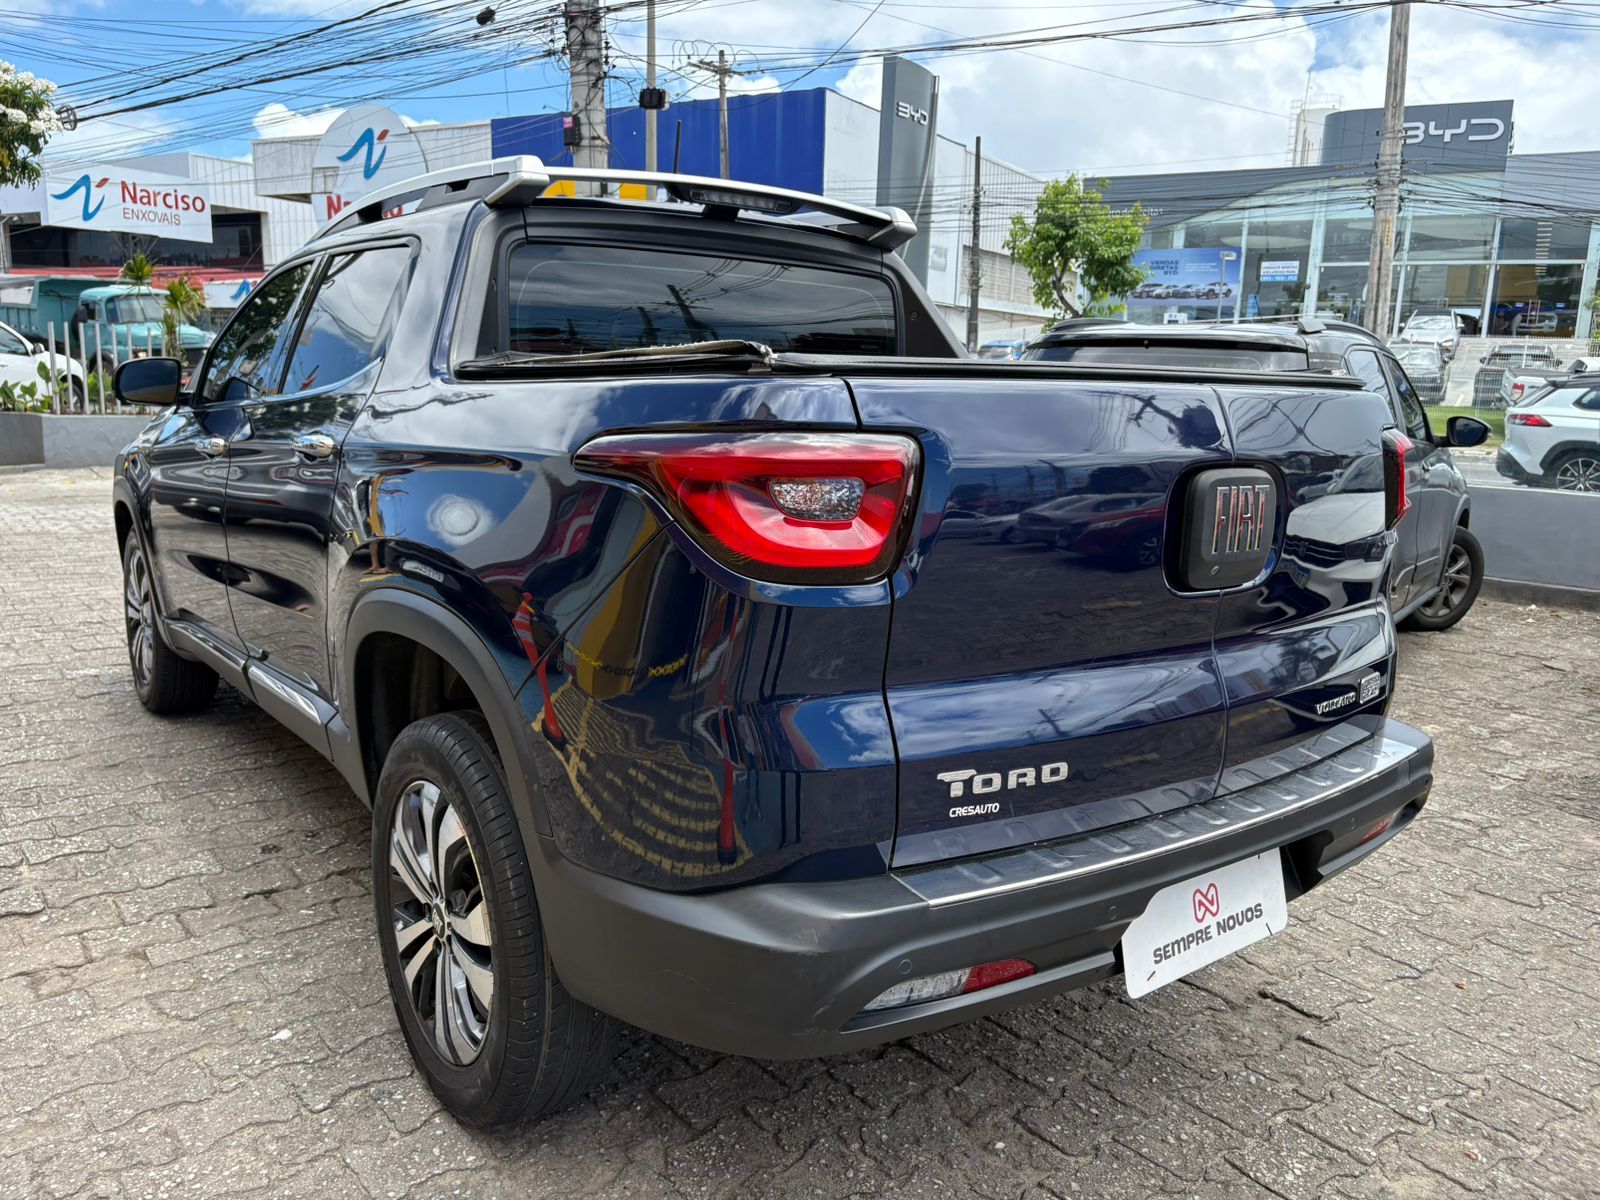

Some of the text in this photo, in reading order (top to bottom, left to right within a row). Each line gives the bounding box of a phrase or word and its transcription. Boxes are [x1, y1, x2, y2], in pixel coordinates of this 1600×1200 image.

[896, 101, 929, 126] BYD
[1402, 118, 1505, 144] BYD
[120, 180, 206, 213] Narciso
[122, 207, 182, 226] ENXOVAIS
[1211, 484, 1270, 555] FIAT
[937, 762, 1068, 798] TORO
[949, 802, 1000, 818] CRESAUTO
[1153, 925, 1213, 965] SEMPRE
